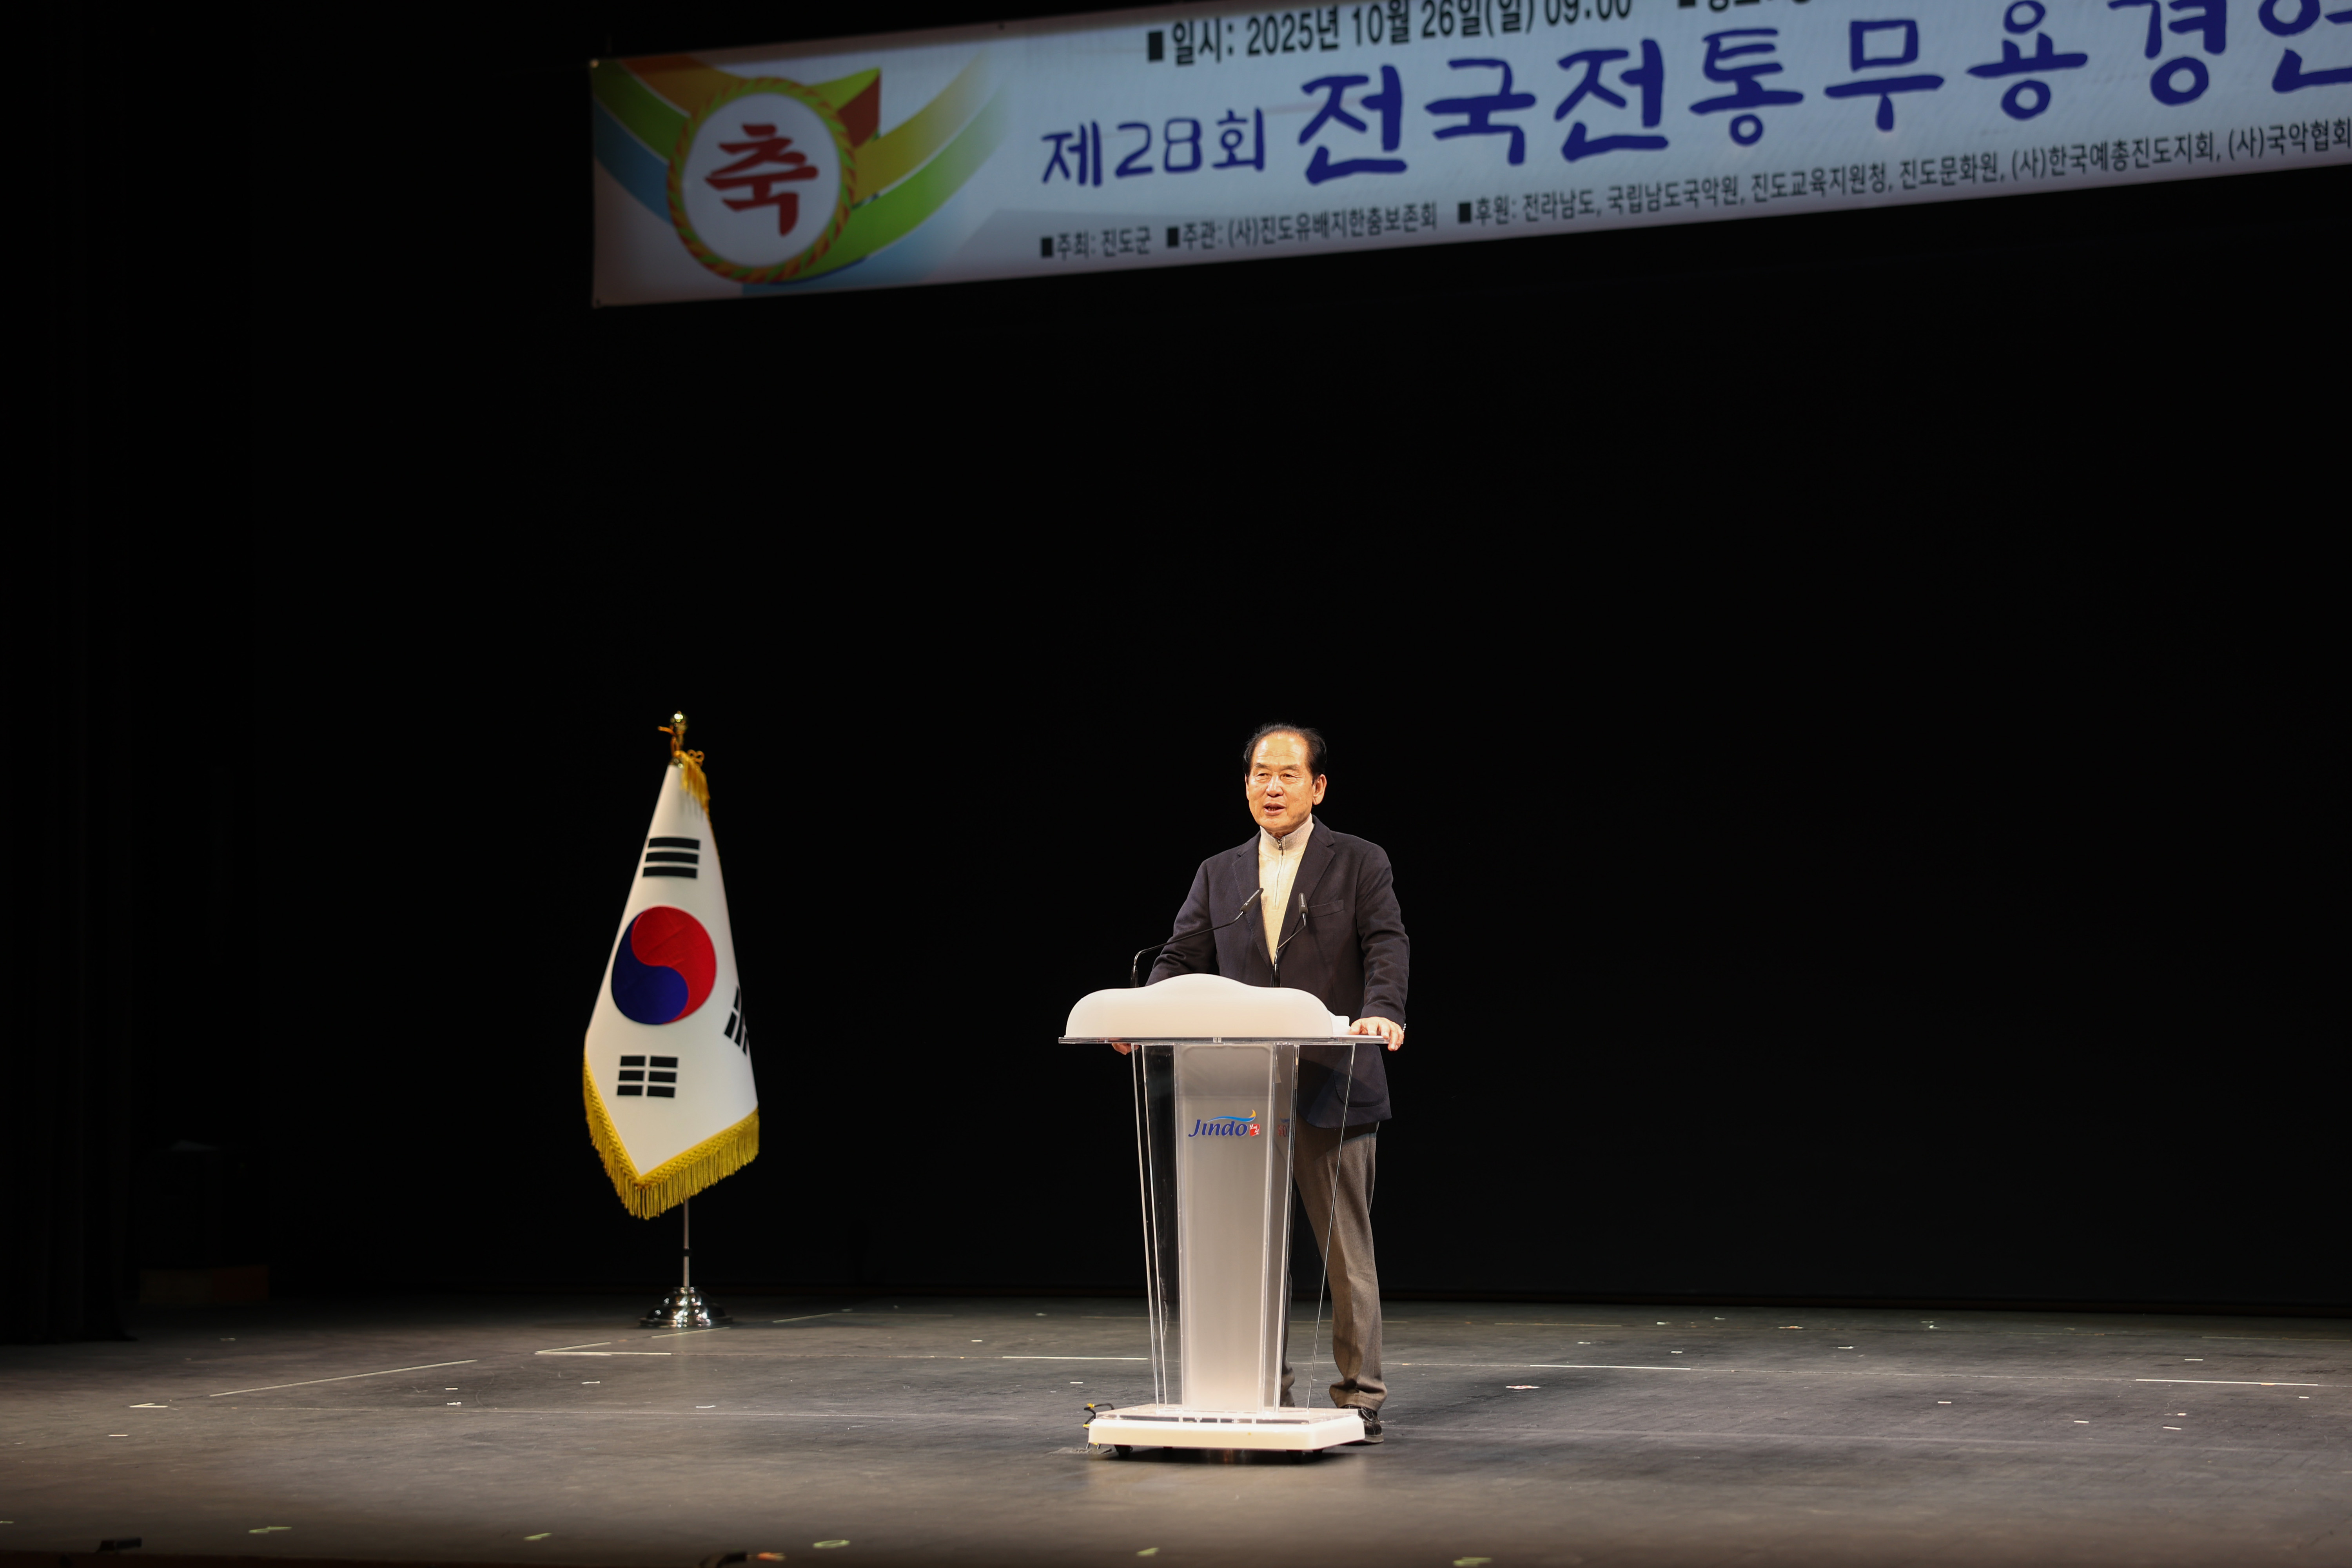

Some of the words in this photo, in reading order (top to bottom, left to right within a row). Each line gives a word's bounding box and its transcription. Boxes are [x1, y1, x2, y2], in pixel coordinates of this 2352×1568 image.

[1172, 18, 1234, 65] 일시:
[1247, 6, 1339, 56] 2025년
[1352, 0, 1410, 45] 10월
[704, 123, 819, 237] 축
[1041, 107, 1266, 187] 제28회
[1057, 229, 1096, 260] 주최:
[1102, 226, 1151, 257] 진도군
[1183, 220, 1223, 250] 주관:
[1475, 196, 1517, 226] 후원:
[1523, 189, 1601, 222] 전라남도,
[1608, 175, 1745, 215] 국립남도국악원,
[1751, 162, 1893, 203] 진도교육지원청,
[1899, 151, 2005, 190] 진도문화원,
[2012, 131, 2220, 181] (사)한국예총진도지회,
[2228, 116, 2352, 161] (사)국악협회
[1188, 1119, 1248, 1137] Jindo
